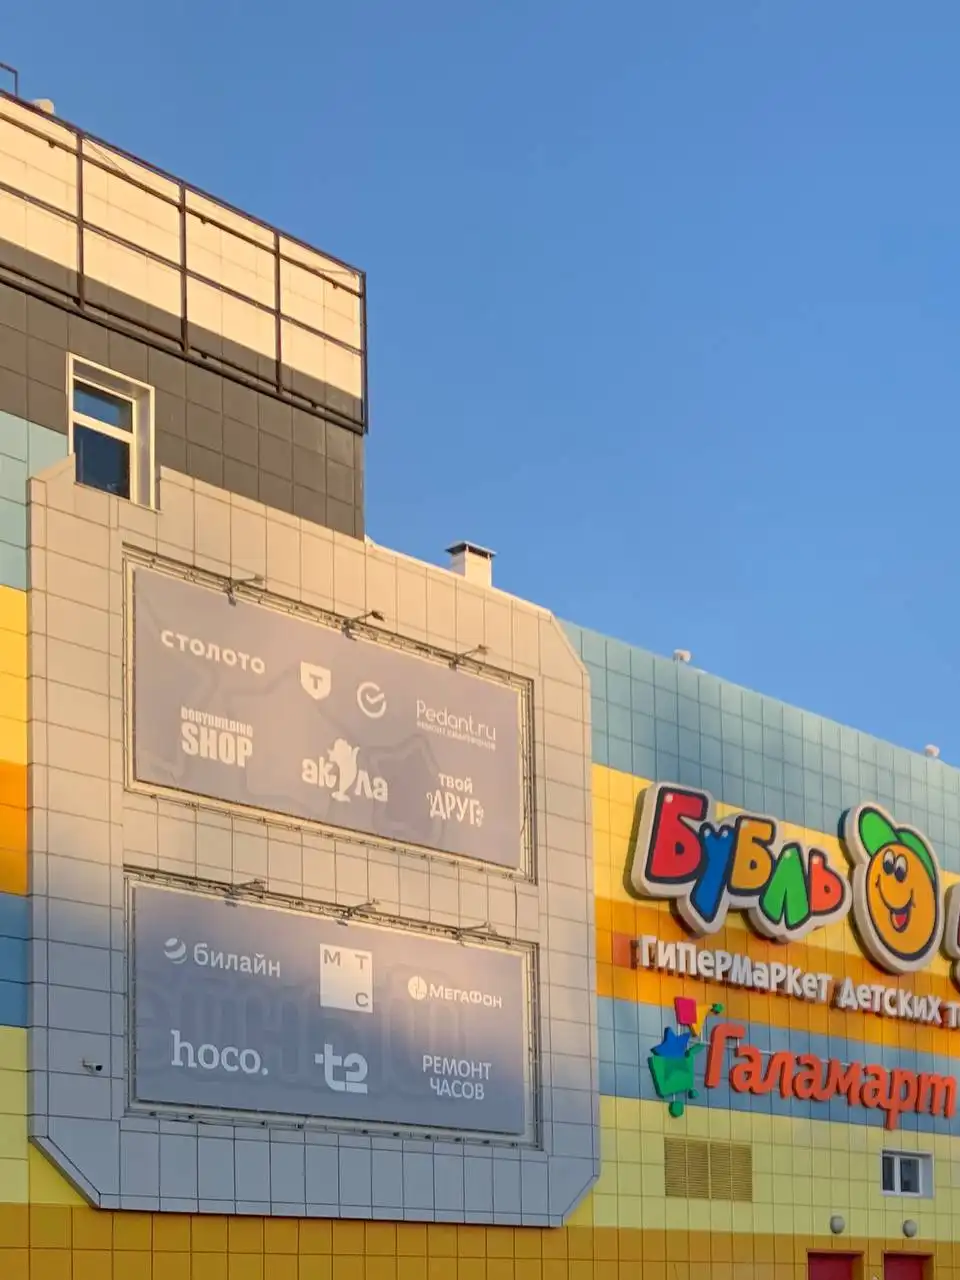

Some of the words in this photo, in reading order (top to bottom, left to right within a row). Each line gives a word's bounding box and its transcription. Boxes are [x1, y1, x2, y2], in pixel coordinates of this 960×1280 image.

[160, 629, 266, 675] СТОЛОТО
[416, 698, 496, 741] Pedant.ru
[181, 721, 253, 768] SHOP
[438, 772, 473, 794] ТВОЙ
[428, 789, 481, 825] ДРУГ
[193, 943, 281, 978] билайн
[170, 1029, 269, 1076] hoco.
[314, 1043, 369, 1094] t2
[422, 1055, 492, 1080] РЕМОНТ
[430, 1077, 485, 1100] ЧАСОВ
[705, 1023, 958, 1129] Галамарт
